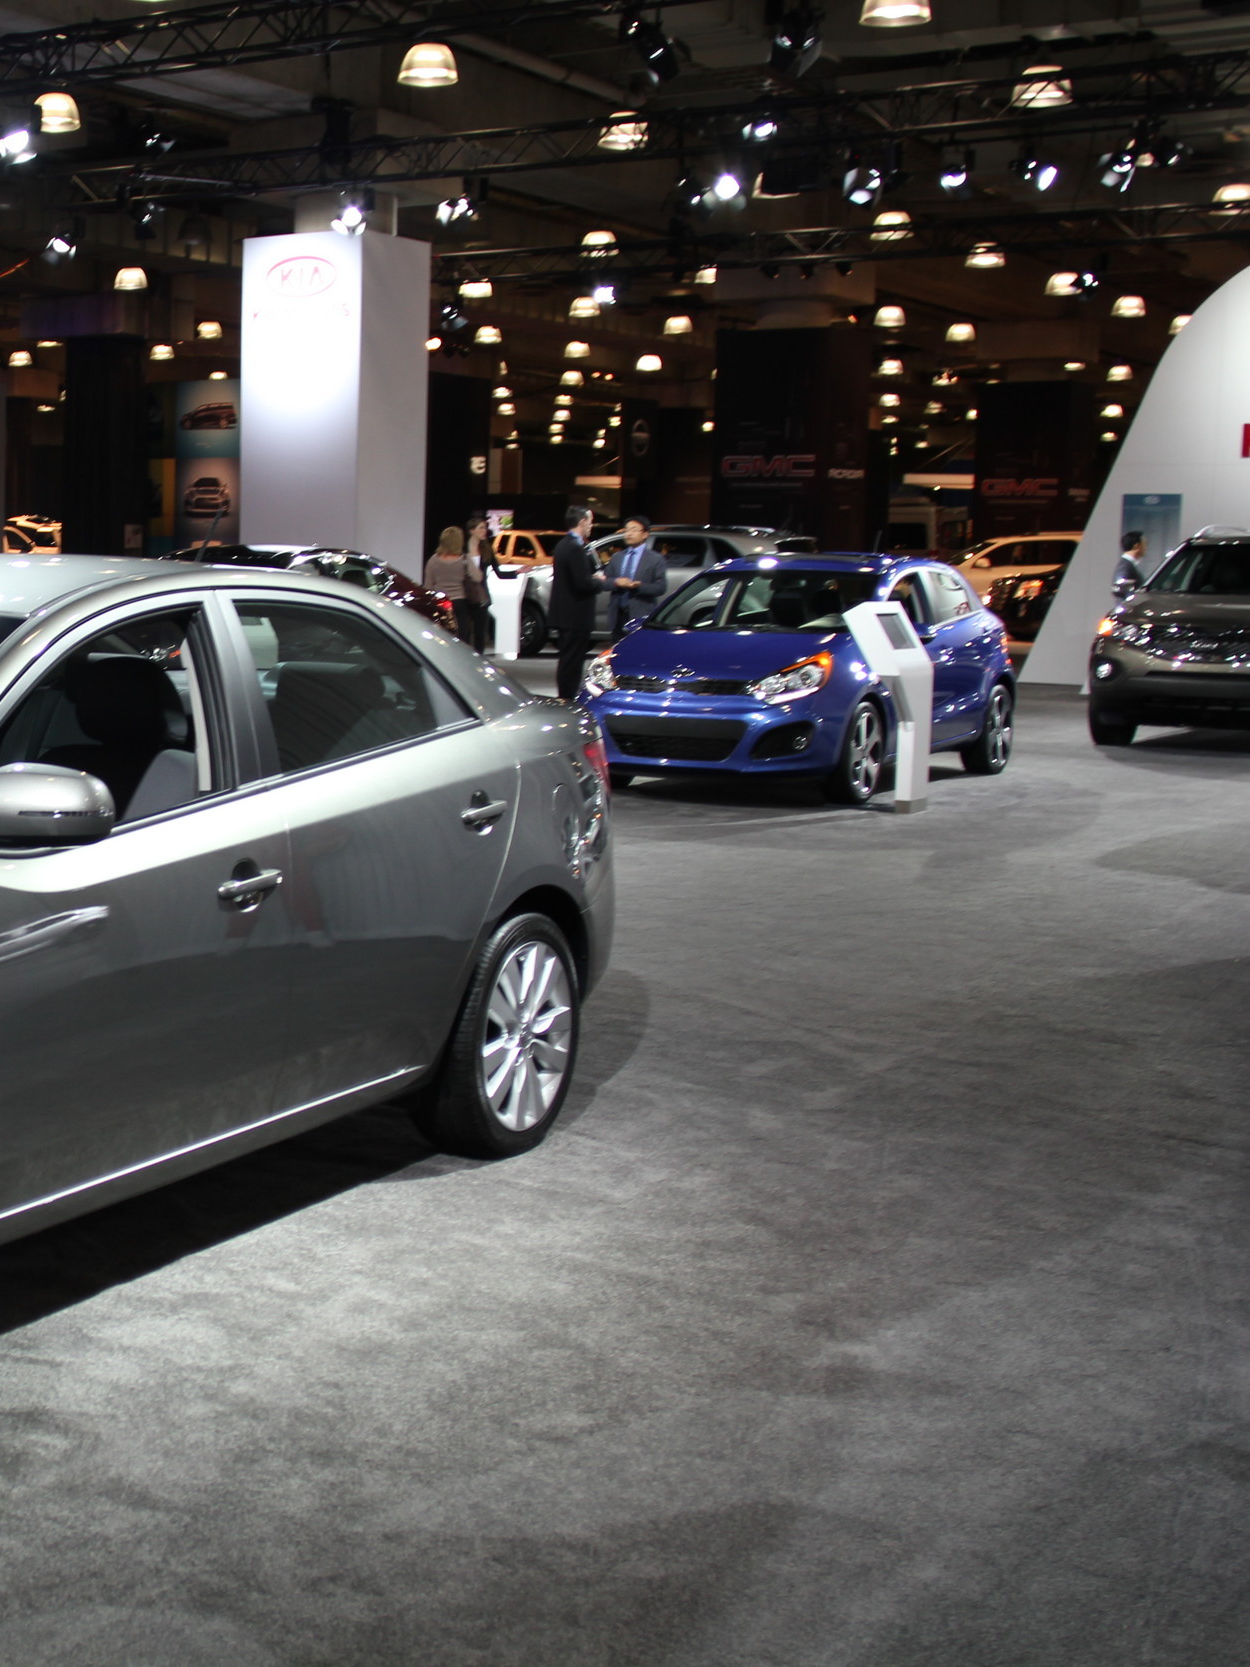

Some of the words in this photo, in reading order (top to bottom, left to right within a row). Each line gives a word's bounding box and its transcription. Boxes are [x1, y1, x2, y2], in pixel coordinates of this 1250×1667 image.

[280, 265, 325, 288] KIA
[721, 454, 816, 477] GMC
[980, 478, 1059, 496] GMC
